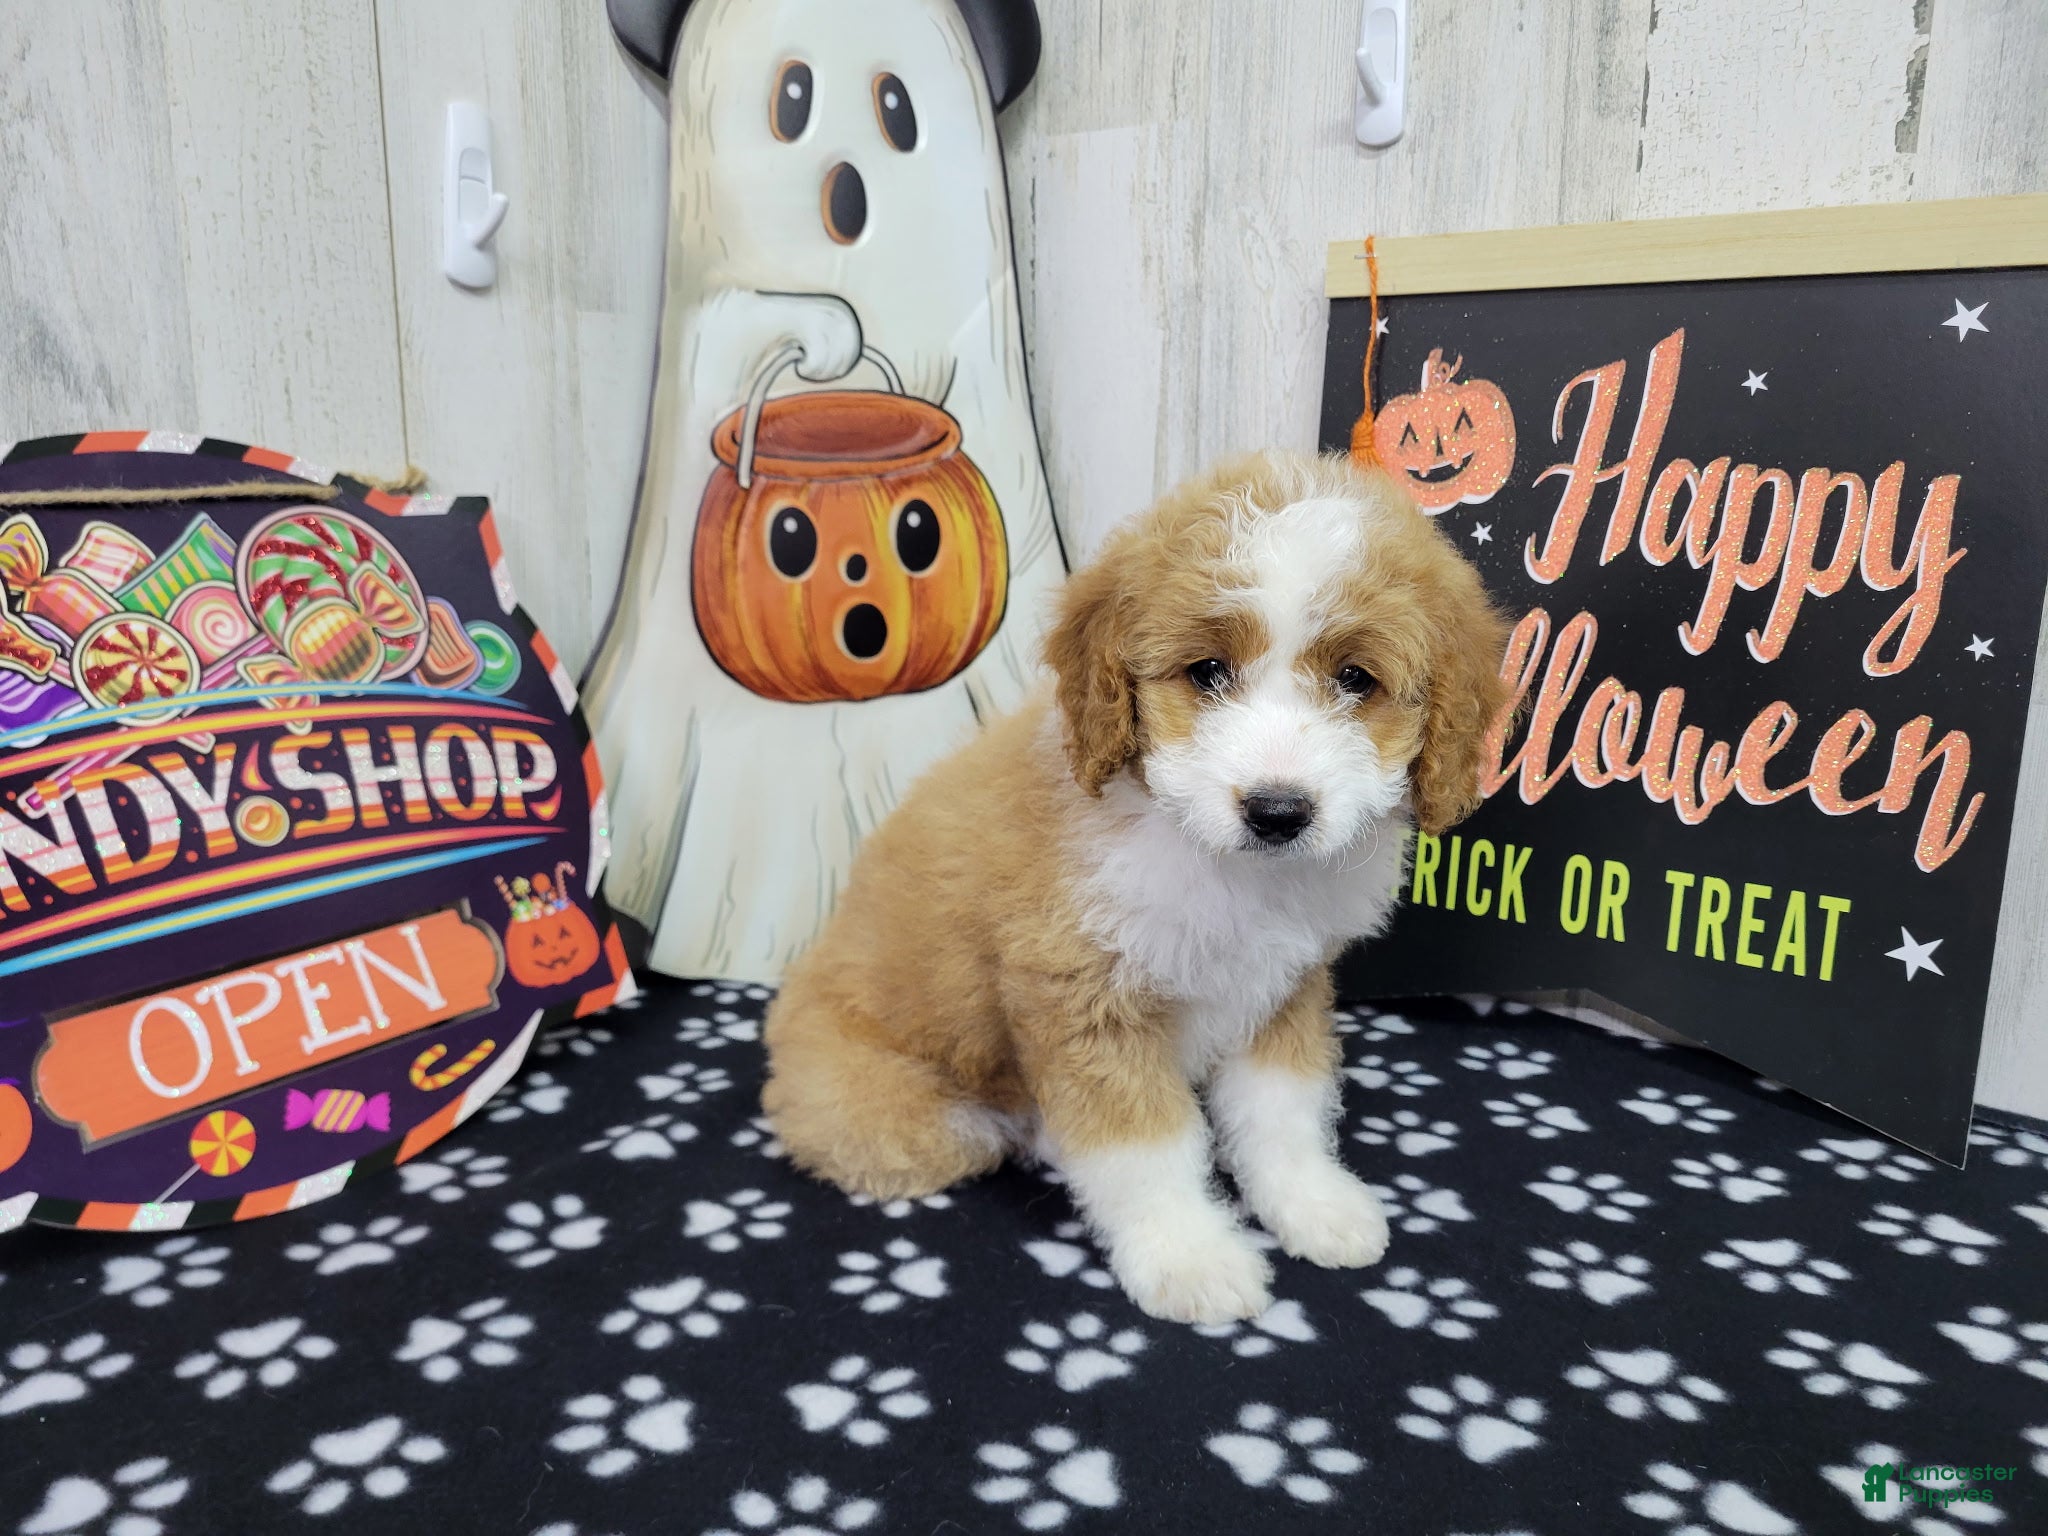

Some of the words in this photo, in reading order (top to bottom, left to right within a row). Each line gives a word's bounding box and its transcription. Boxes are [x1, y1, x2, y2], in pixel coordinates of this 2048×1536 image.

[1525, 327, 1967, 677] Happy
[0, 742, 238, 919] NDY
[271, 722, 558, 838] SHOP
[1477, 608, 1985, 874] lloween
[129, 926, 447, 1097] OPEN
[1559, 854, 1631, 943] OR
[1664, 869, 1852, 981] TREAT
